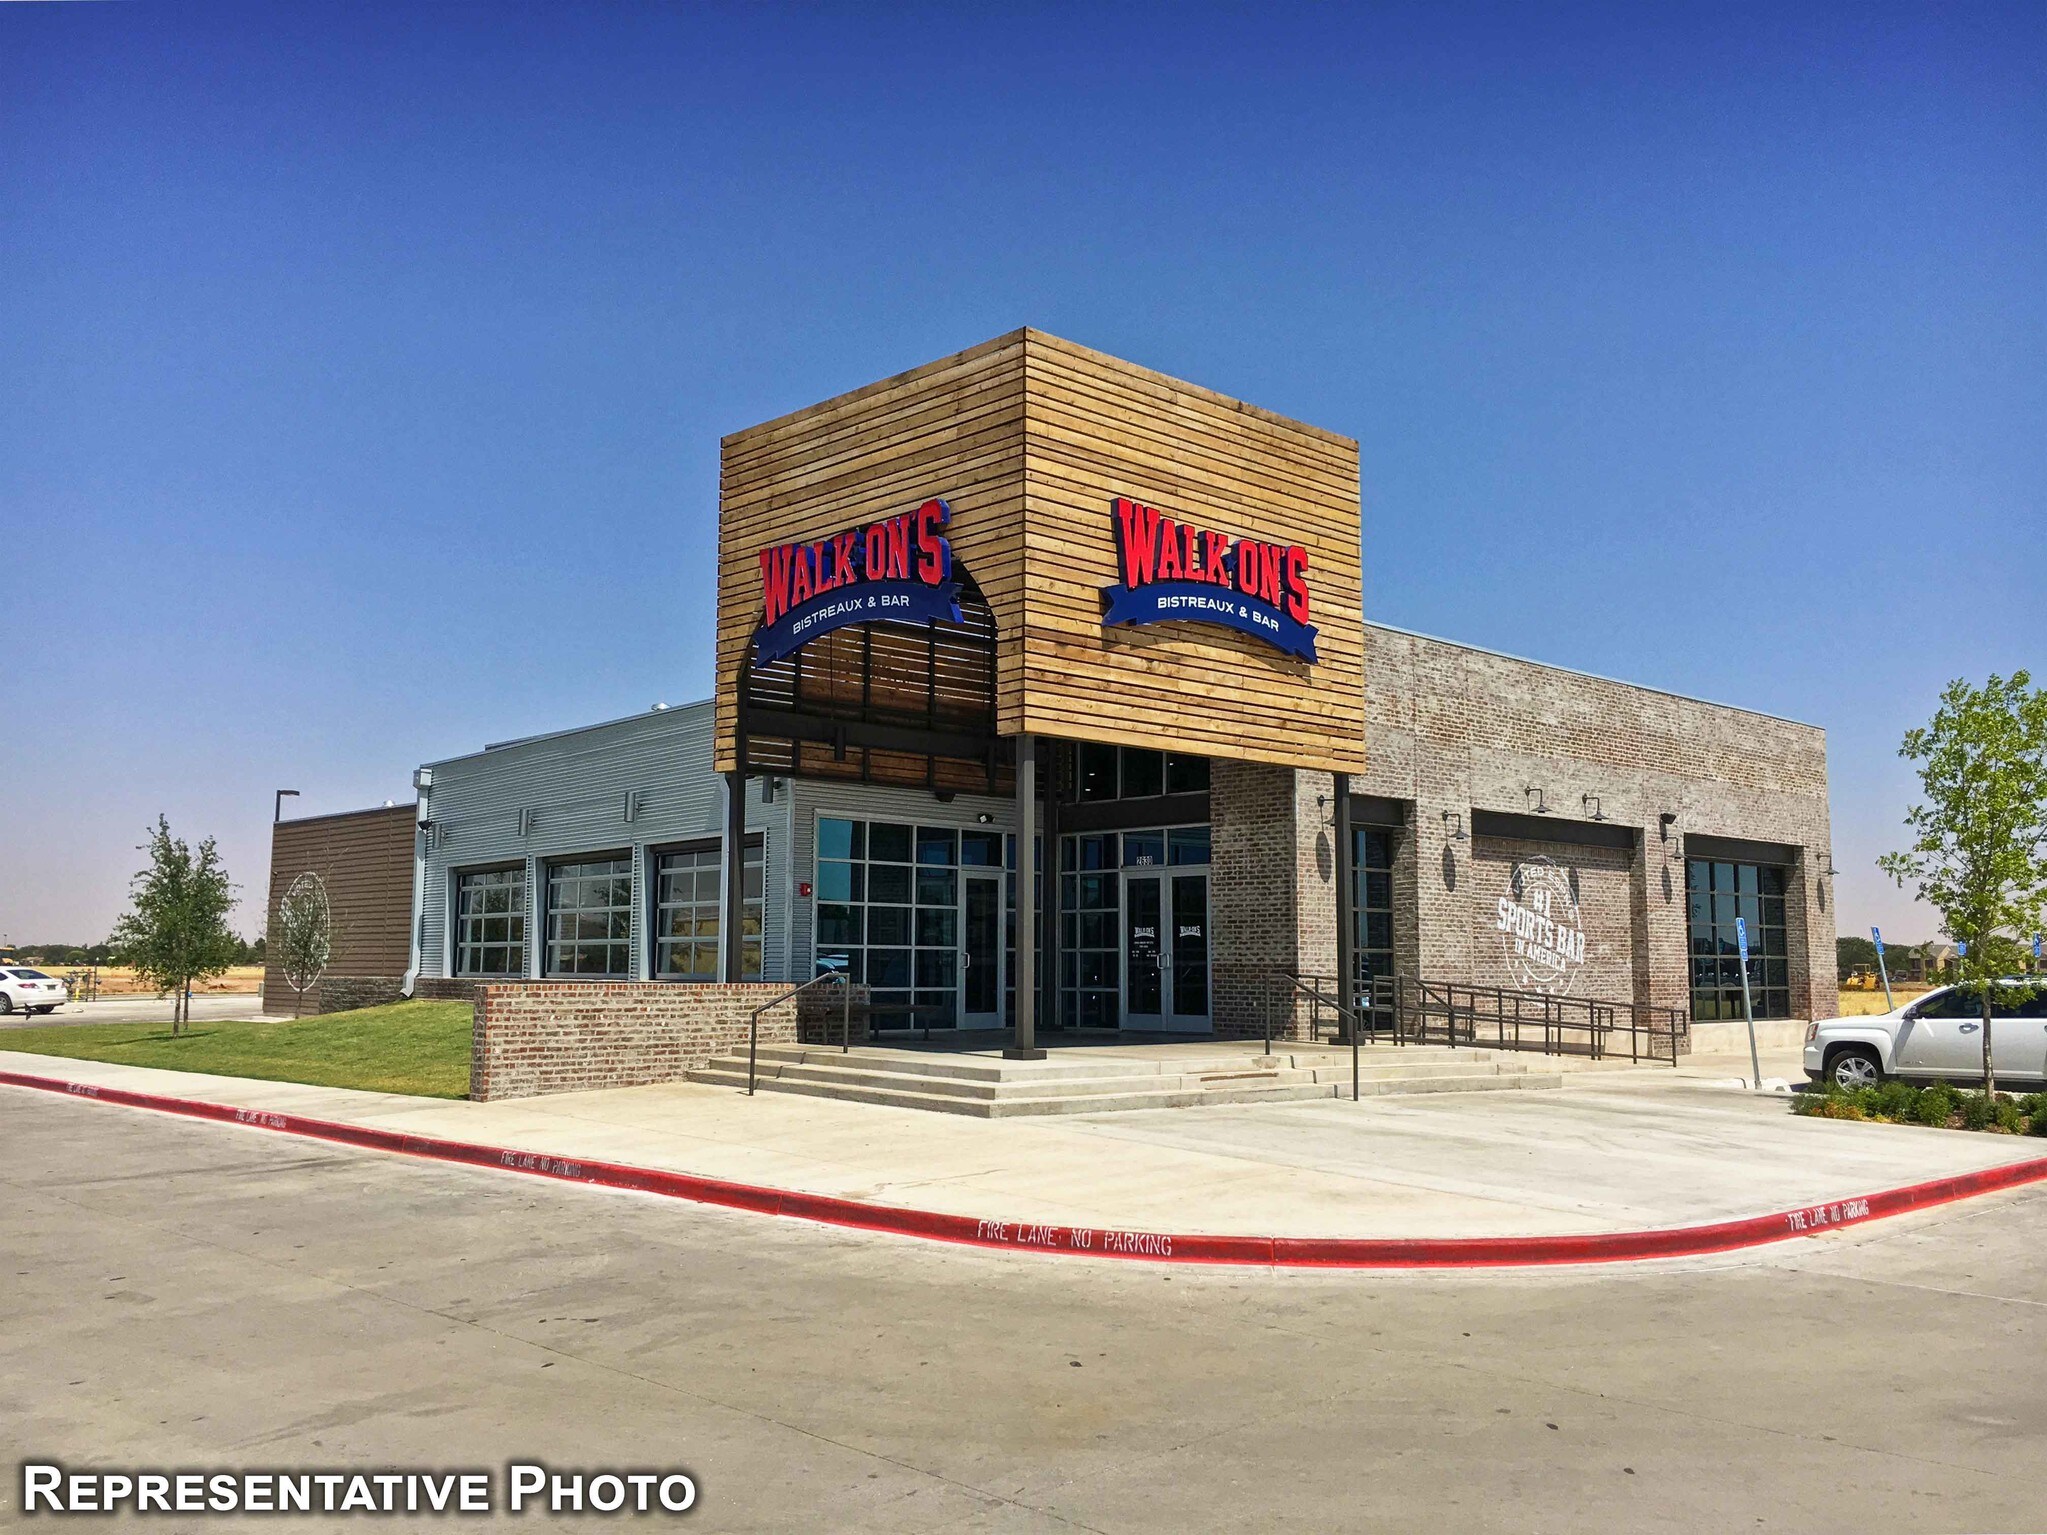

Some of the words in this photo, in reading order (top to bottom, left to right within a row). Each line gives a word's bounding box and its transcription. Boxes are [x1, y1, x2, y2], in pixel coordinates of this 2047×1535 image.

[792, 597, 863, 635] BISTREAUX
[867, 596, 876, 608] &
[881, 595, 910, 607] BAR
[1157, 596, 1235, 615] BISTREAUX
[1239, 606, 1248, 619] &
[1252, 610, 1280, 632] BAR
[1533, 889, 1551, 918] #1
[1497, 897, 1554, 949] SPORTS
[1557, 924, 1585, 966] BAR
[1515, 938, 1525, 955] IN
[1526, 943, 1566, 973] AMERICA
[500, 1151, 516, 1166] FIRE
[518, 1155, 537, 1169] LANE
[539, 1157, 550, 1171] NO
[552, 1160, 581, 1177] PARKING
[1787, 1212, 1808, 1231] FIRE
[1807, 1207, 1828, 1227] LANE
[1830, 1205, 1840, 1222] NO
[1842, 1199, 1869, 1219] PARKING
[977, 1220, 1010, 1241] FIRE
[1017, 1224, 1058, 1246] LANE
[1070, 1228, 1091, 1247] NO
[1104, 1232, 1172, 1256] PARKING
